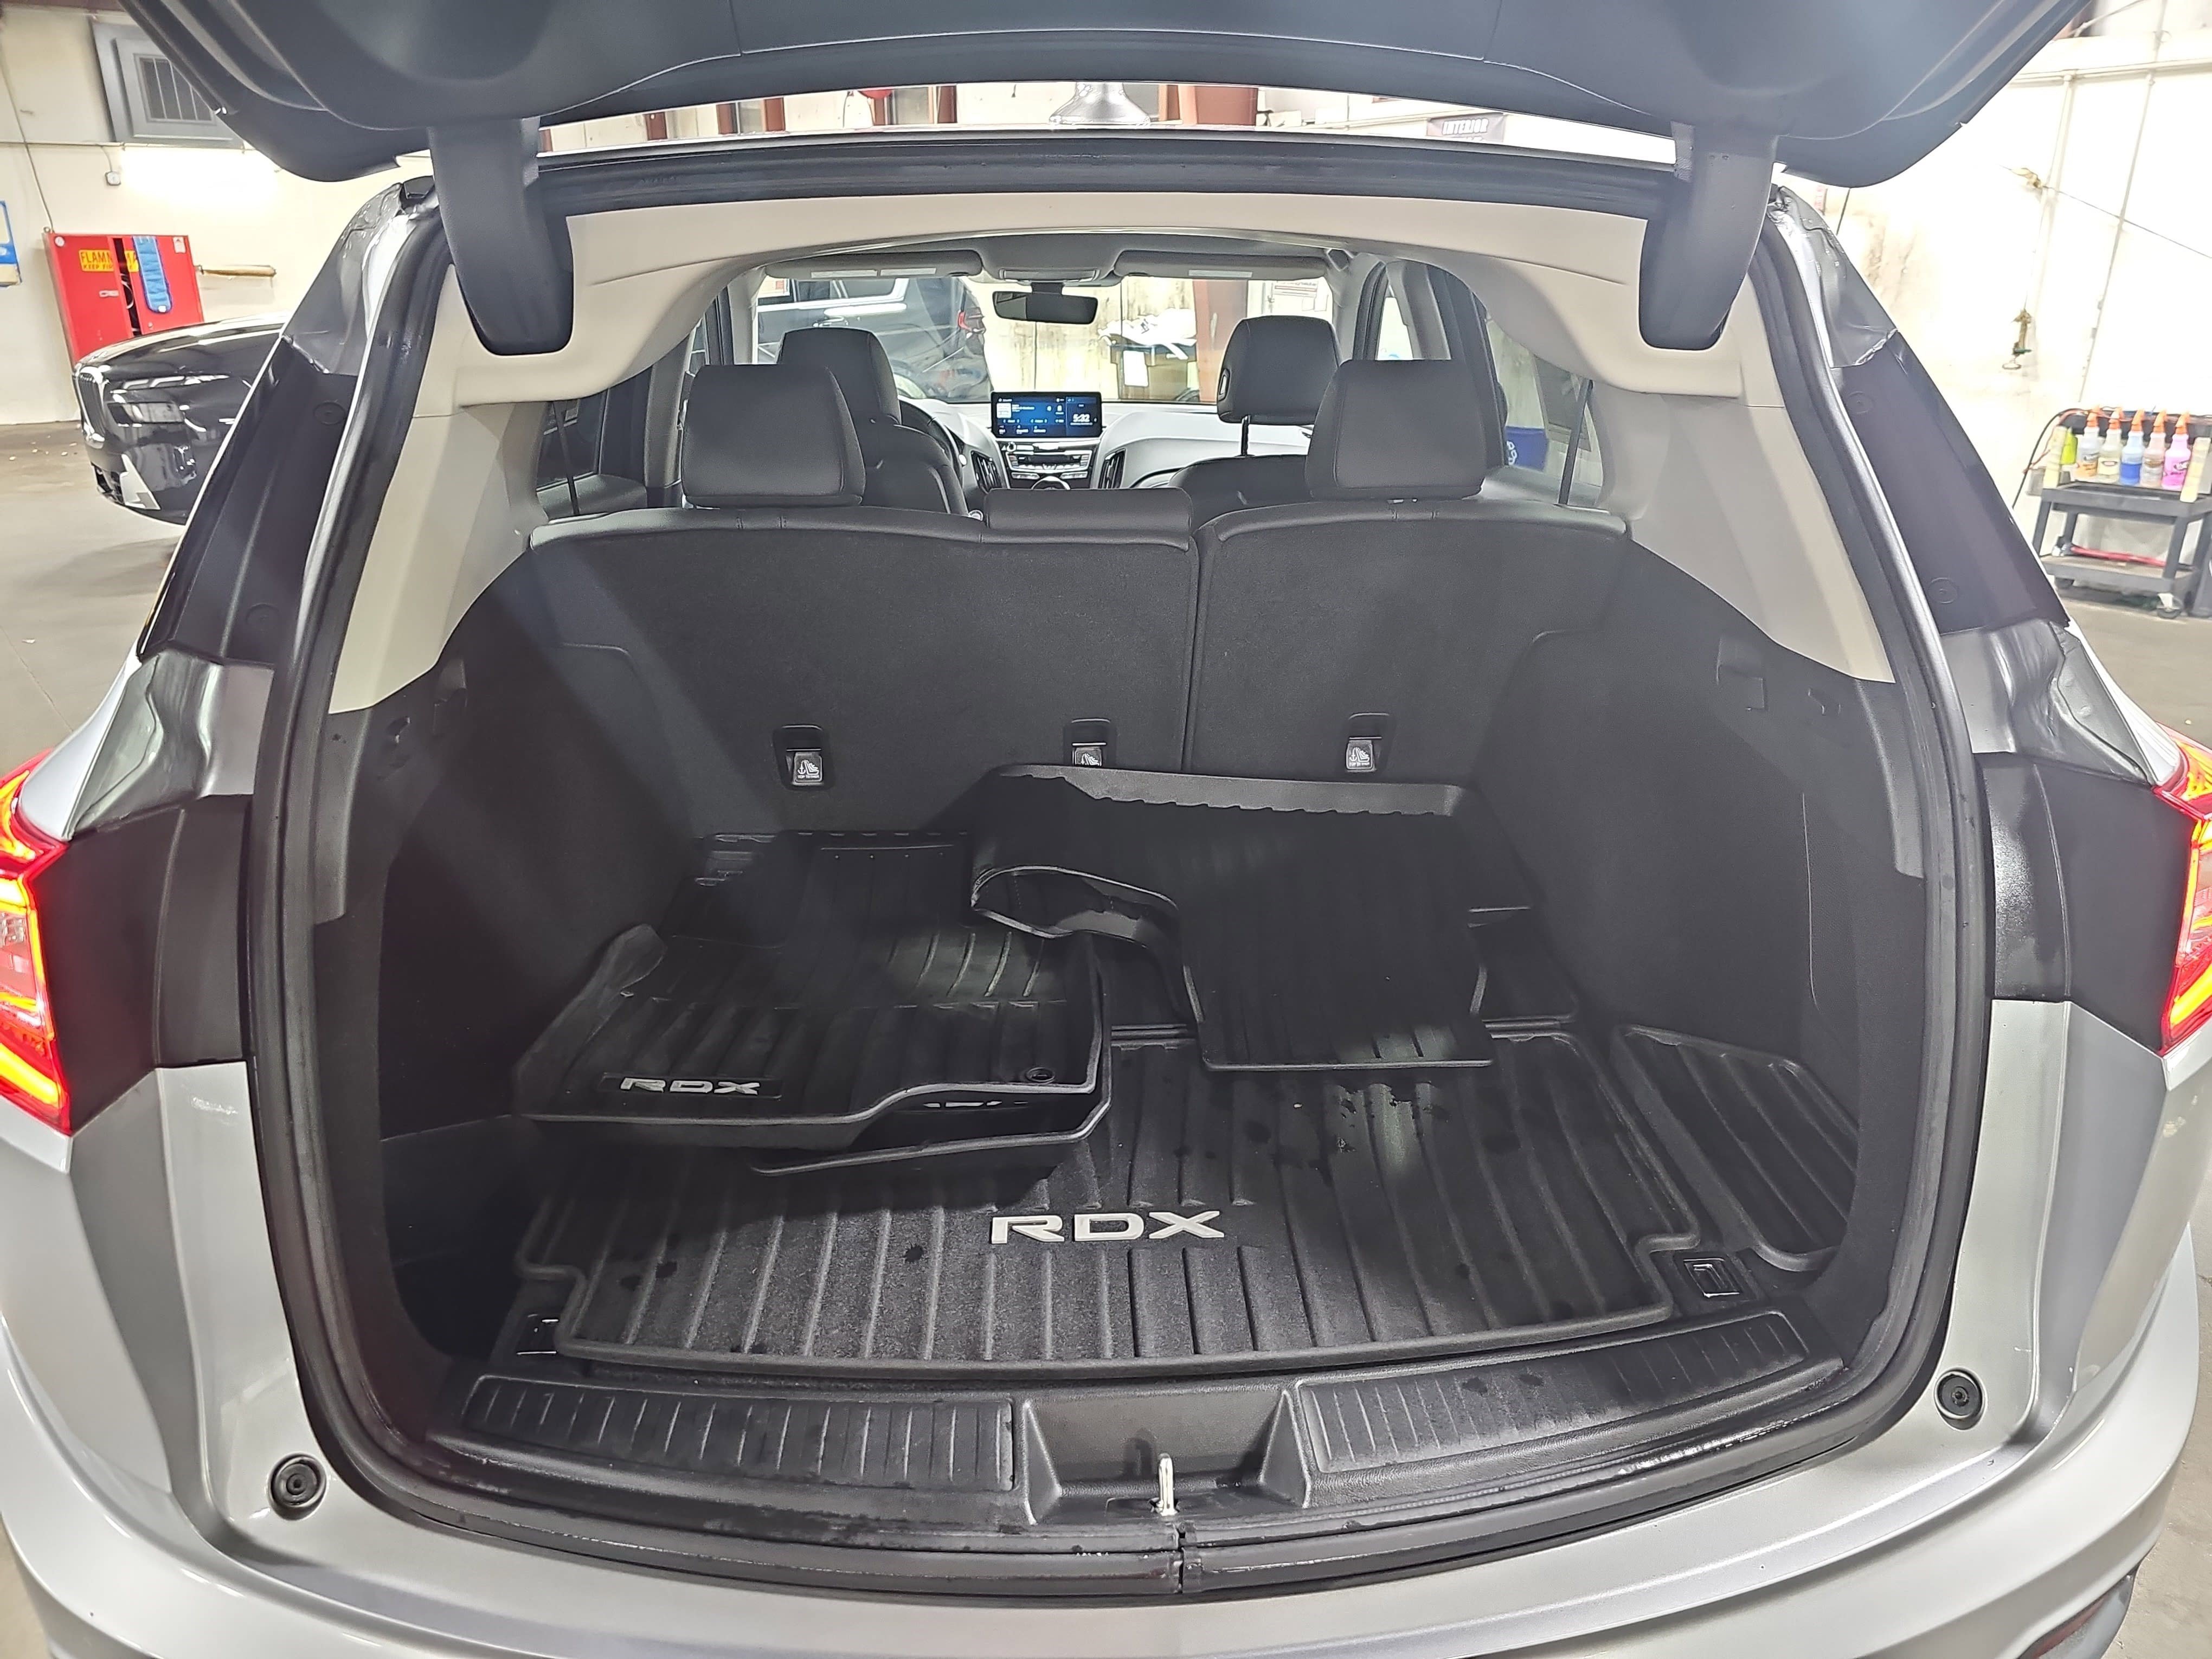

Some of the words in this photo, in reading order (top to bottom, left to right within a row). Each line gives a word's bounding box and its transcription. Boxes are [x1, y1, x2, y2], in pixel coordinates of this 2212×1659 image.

[1442, 118, 1489, 135] INTERIOR
[620, 1077, 760, 1096] RDX
[991, 1211, 1225, 1244] RDX
